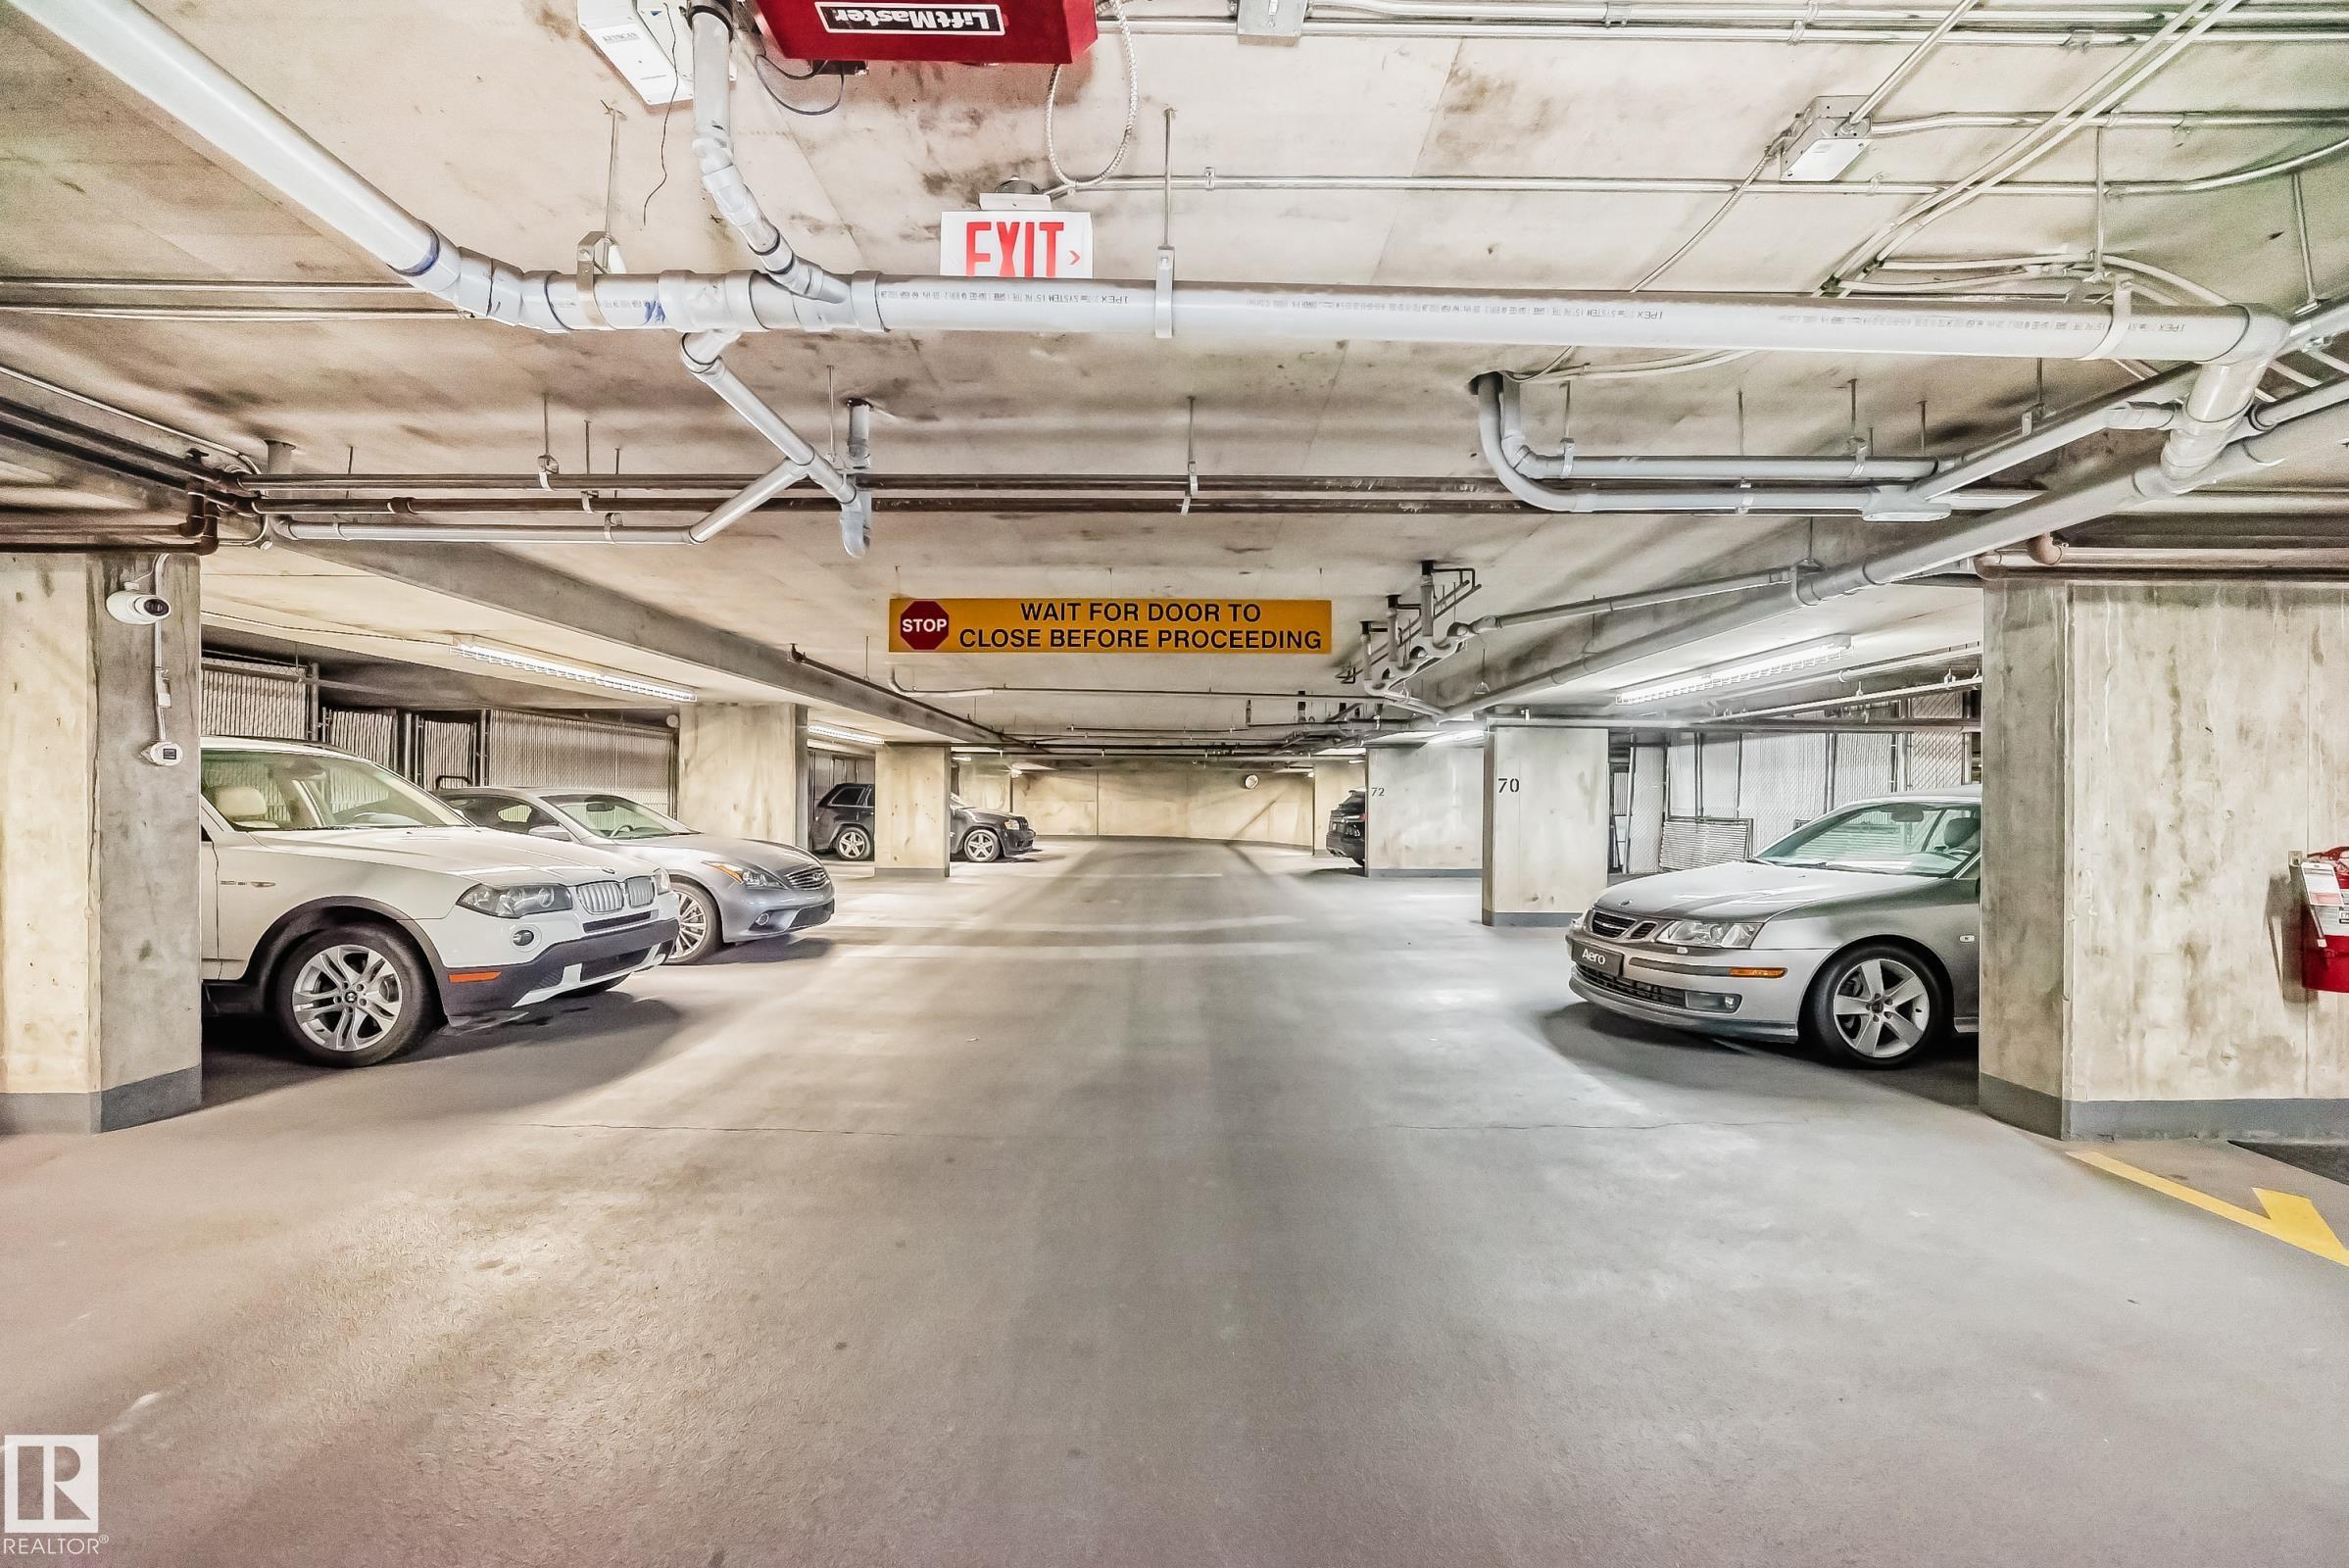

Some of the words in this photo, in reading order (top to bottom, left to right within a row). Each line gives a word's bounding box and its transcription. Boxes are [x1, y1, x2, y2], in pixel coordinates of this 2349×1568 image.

[835, 10, 991, 29] LiftMaster
[965, 221, 1064, 278] EXIT
[1021, 603, 1082, 621] WAIT
[1090, 603, 1139, 621] FOR
[1148, 603, 1220, 622] DOOR
[1228, 604, 1261, 622] TO
[902, 618, 948, 633] STOP
[959, 628, 1041, 648] CLOSE
[1050, 629, 1149, 648] BEFORE
[1157, 629, 1321, 649] PROCEEDING
[1371, 787, 1385, 797] 72
[1497, 778, 1520, 794] 70
[1582, 948, 1606, 965] Aero
